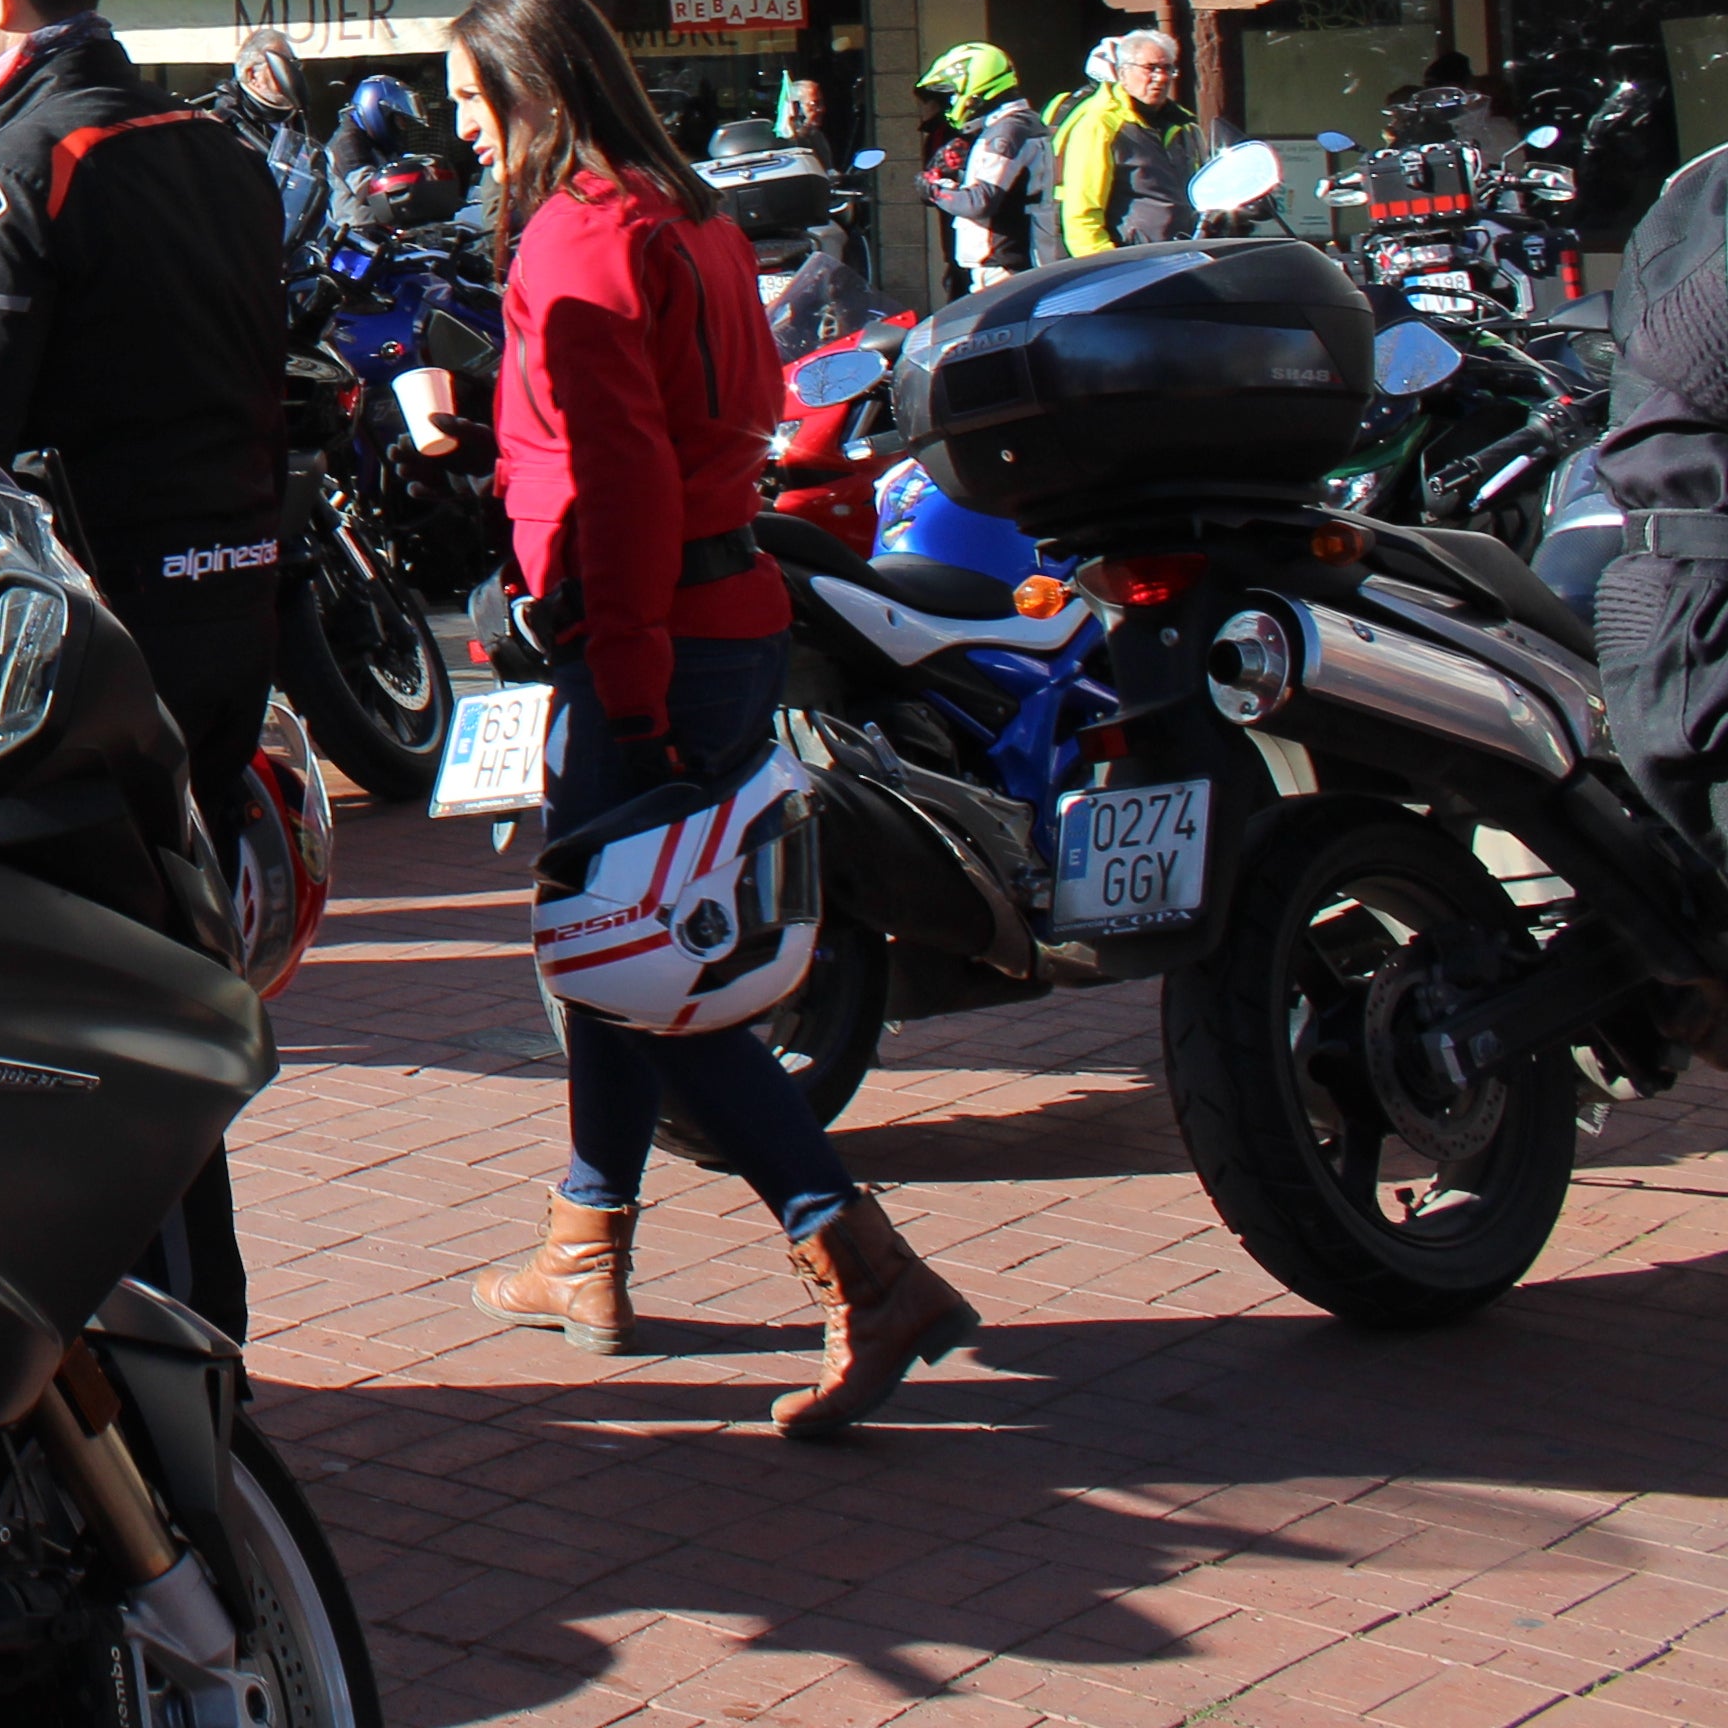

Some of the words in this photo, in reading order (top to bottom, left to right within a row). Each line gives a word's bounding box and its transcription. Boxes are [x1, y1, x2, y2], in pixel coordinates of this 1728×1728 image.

[1092, 790, 1197, 852] 0274
[1068, 847, 1082, 866] E
[1102, 849, 1179, 907] GGY
[1108, 910, 1192, 928] COPA
